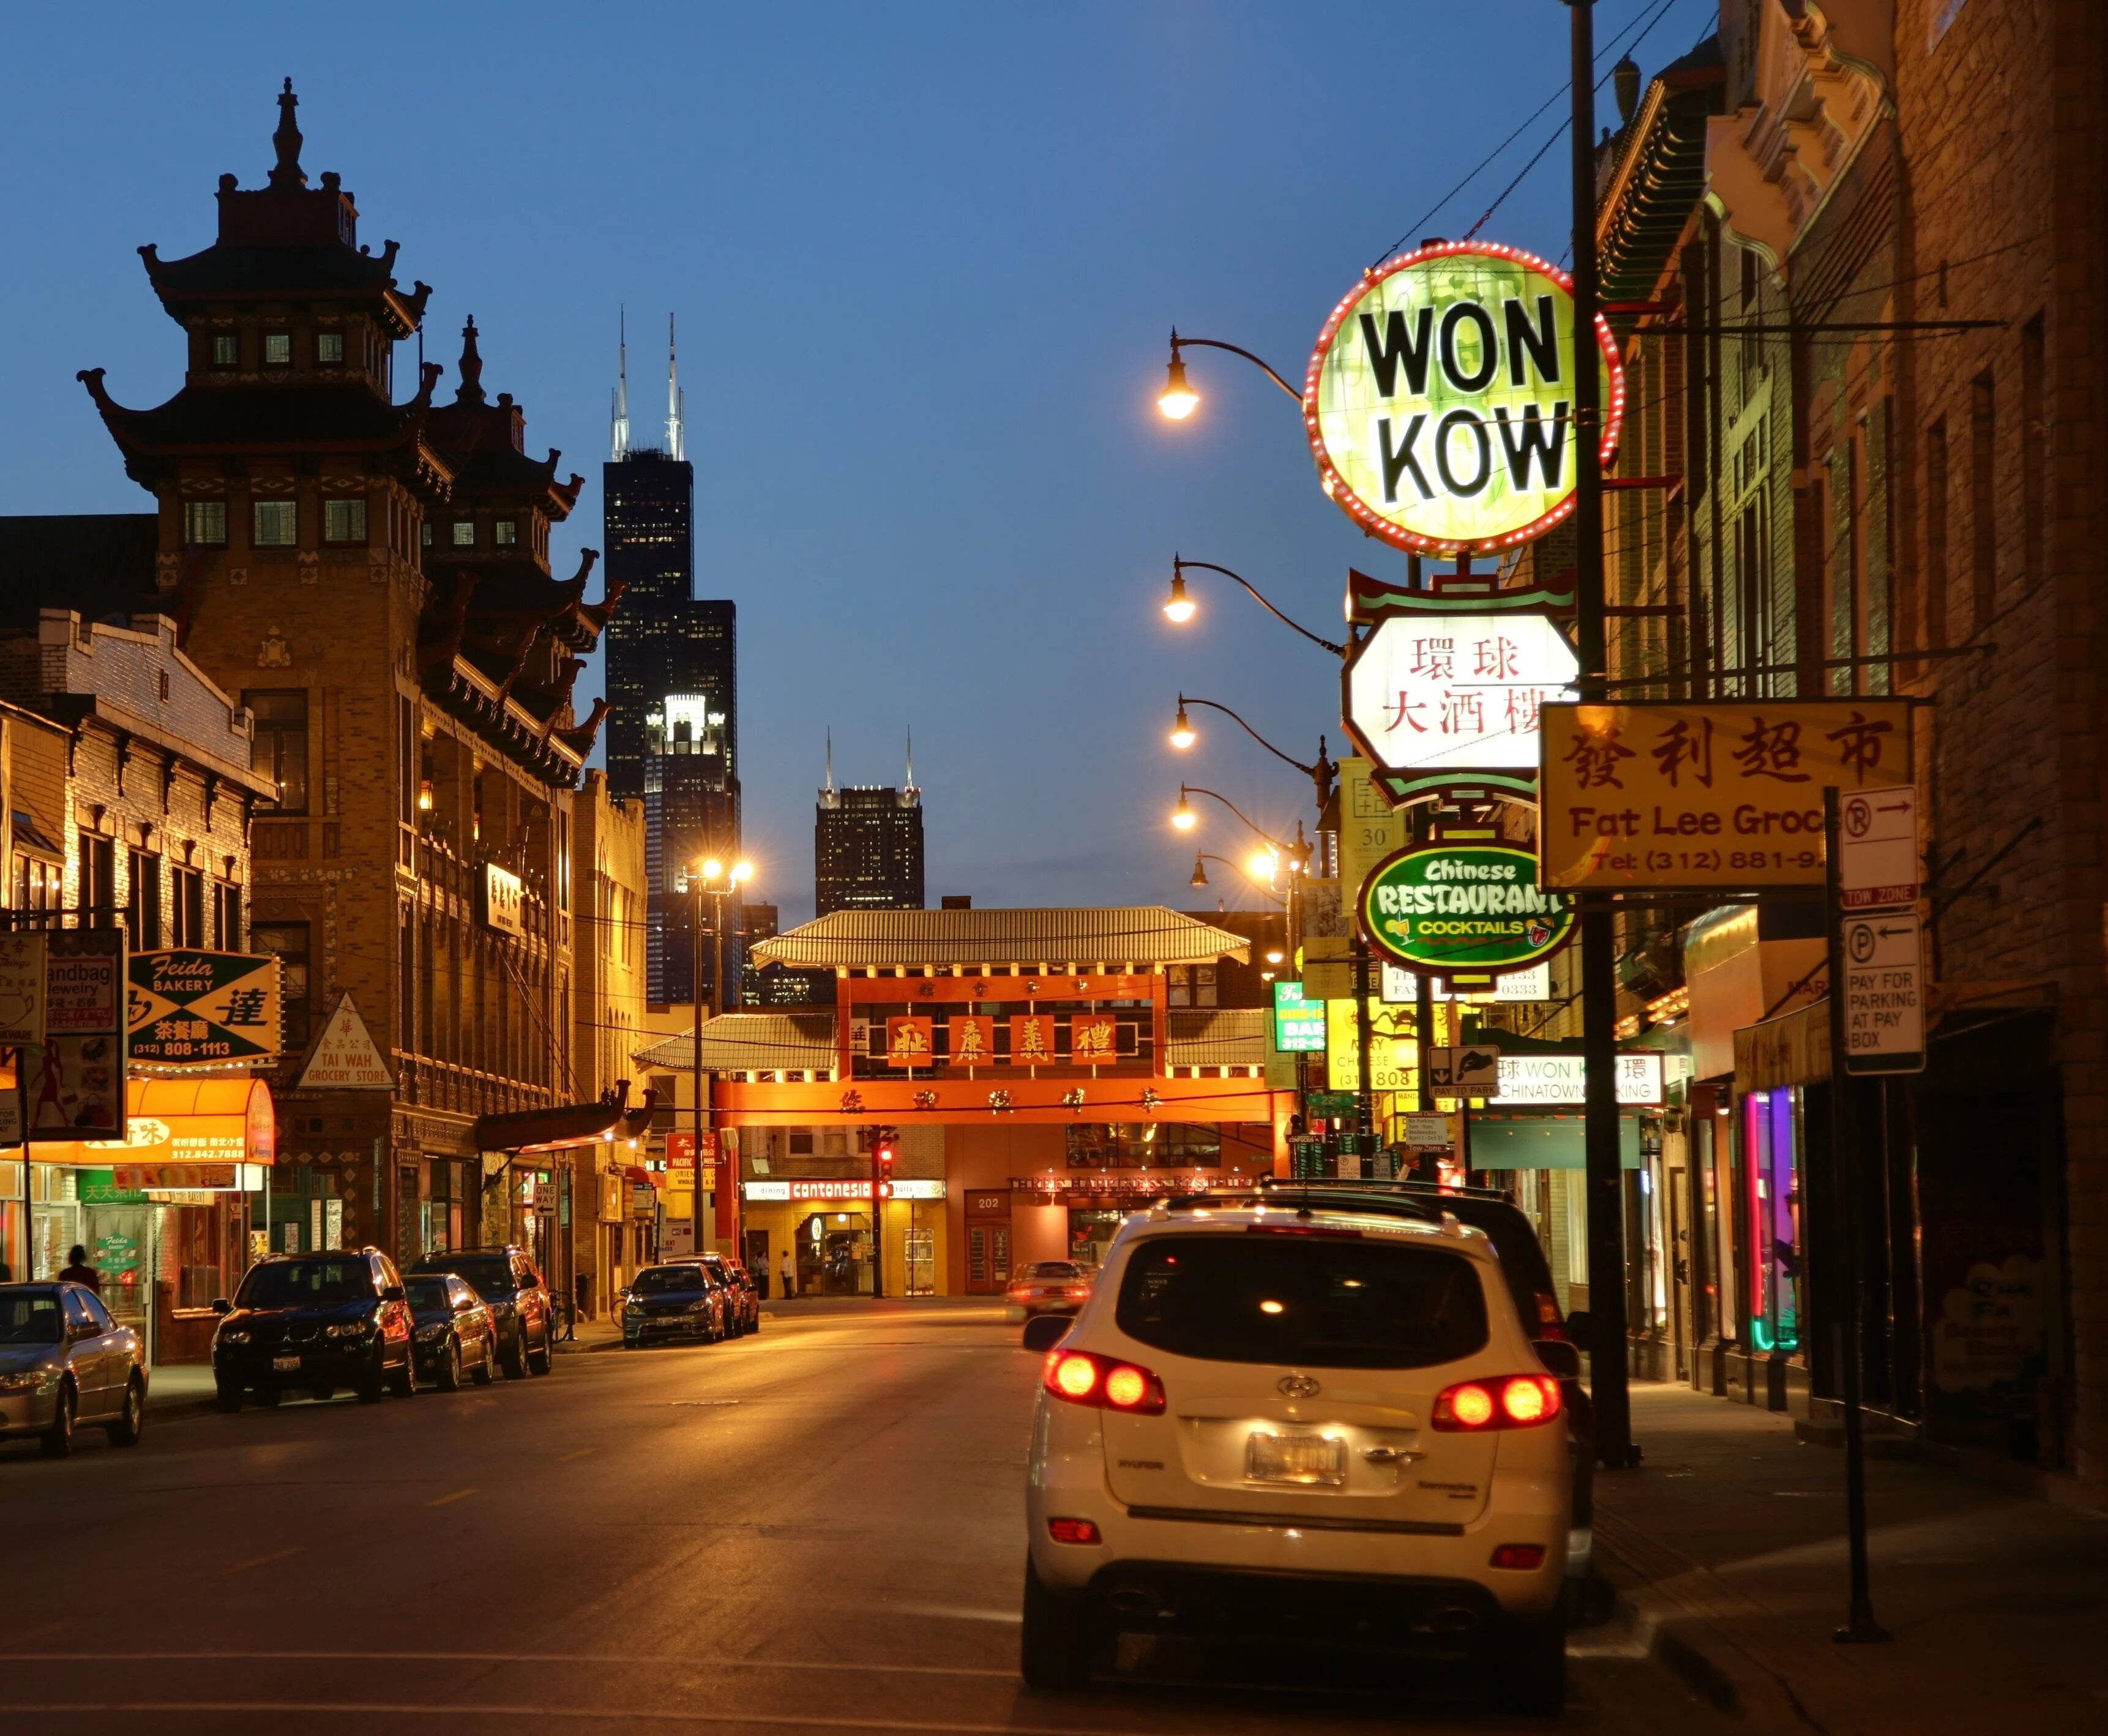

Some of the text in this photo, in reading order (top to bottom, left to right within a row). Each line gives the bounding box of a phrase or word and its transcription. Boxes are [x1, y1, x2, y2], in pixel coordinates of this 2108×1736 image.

[1359, 296, 1560, 398] WON
[1378, 402, 1569, 503] KOW
[1410, 636, 1519, 680] 環球
[1382, 687, 1545, 735] 大酒樓
[1563, 711, 1894, 790] 發利超市
[1568, 804, 1825, 837] Fat Lee Groc
[1594, 851, 1638, 870] Tel:
[1645, 850, 1721, 872] (312)
[1425, 859, 1517, 881] Chinese
[1847, 886, 1912, 905] TOW ZONE
[1418, 921, 1525, 935] COCKTAILS
[48, 963, 110, 985] andbag
[150, 955, 214, 980] Feida
[153, 980, 213, 992] BAKERY
[1788, 980, 1830, 995] MAR
[1849, 973, 1913, 991] PAY FOR
[1849, 991, 1917, 1010] PARKING
[1852, 1011, 1902, 1029] AT PAY
[154, 1020, 209, 1041] 茶餐廳
[321, 1036, 372, 1051] 食品公司
[1850, 1031, 1881, 1049] BOX
[134, 1042, 230, 1056] (312) 808-1113
[321, 1053, 373, 1068] TAI WAH
[1337, 1056, 1389, 1067] CHESE
[308, 1070, 385, 1082] GROCERY STORE
[1525, 1062, 1571, 1079] WON
[1340, 1075, 1359, 1087] (31
[1455, 1087, 1467, 1095] TO
[1470, 1086, 1495, 1094] PARK
[1500, 1084, 1586, 1099] CHINATOWN
[171, 1150, 244, 1159] 312.842.7888
[672, 1158, 692, 1167] PACIFIC
[536, 1186, 555, 1194] ONE
[793, 1182, 872, 1198] cantonesia
[1007, 1177, 1063, 1193] THREE
[1070, 1176, 1166, 1192] HAPPINESS
[978, 1198, 999, 1209] 202
